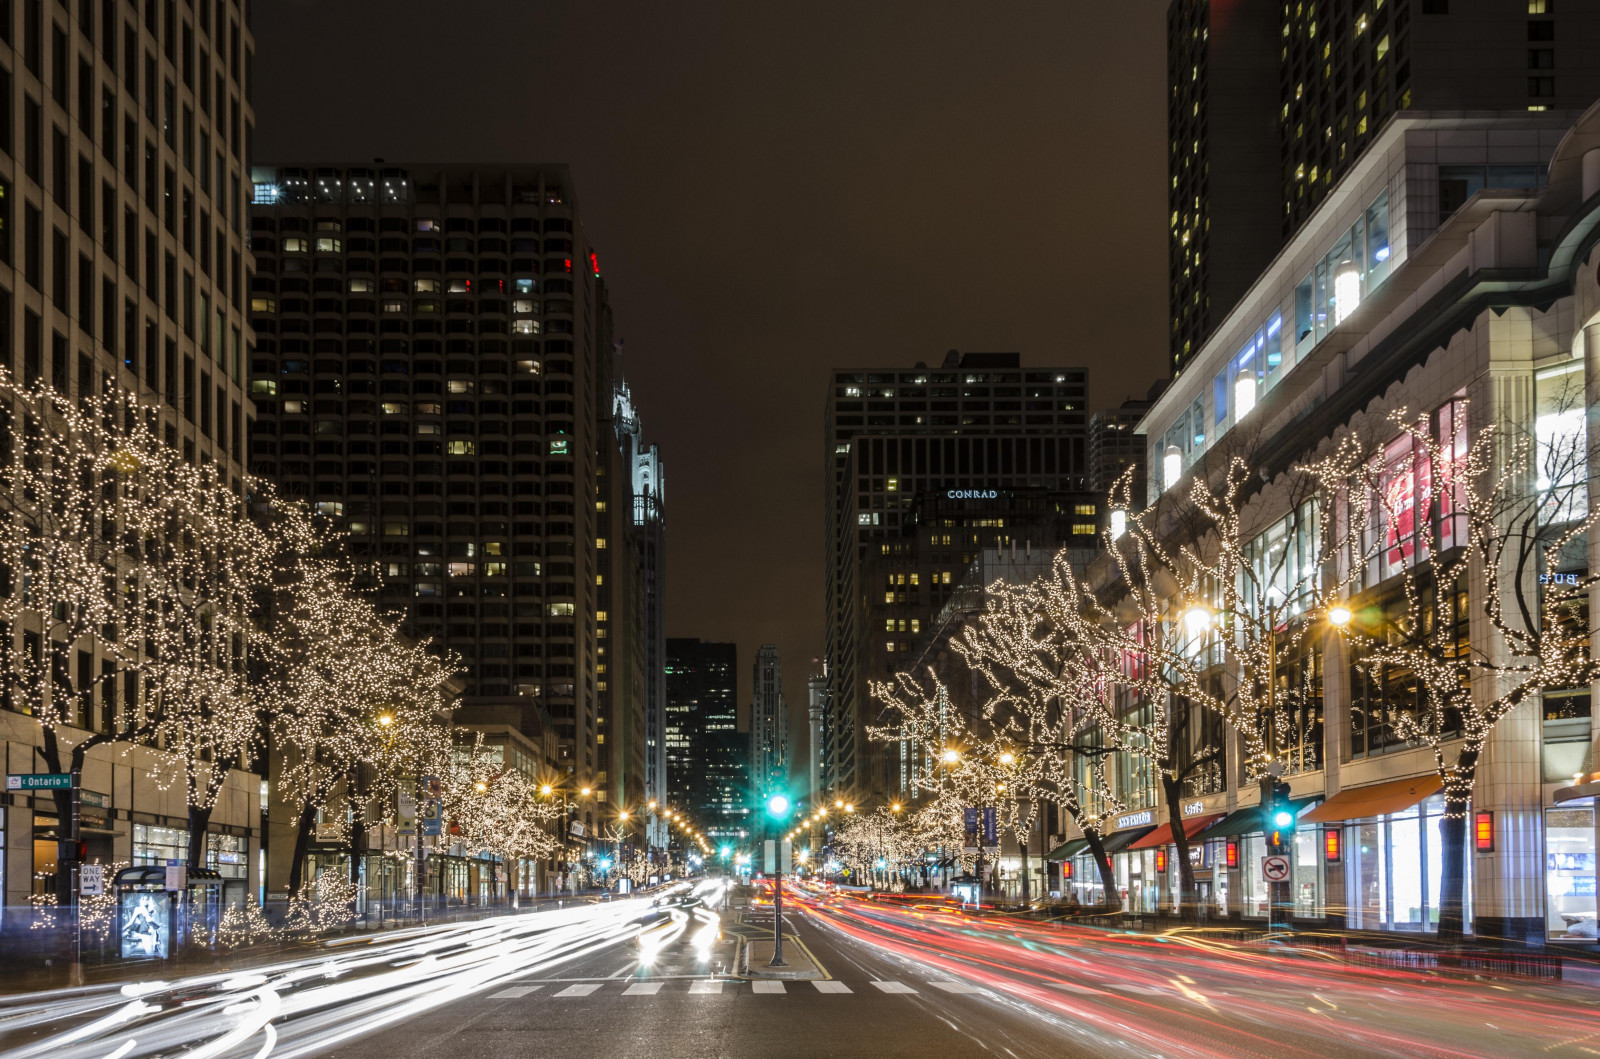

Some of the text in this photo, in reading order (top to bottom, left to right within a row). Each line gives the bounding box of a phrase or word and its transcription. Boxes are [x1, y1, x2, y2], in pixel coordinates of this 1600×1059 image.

[947, 489, 998, 499] CONRAD
[28, 777, 61, 786] Ontario
[83, 867, 100, 875] ONE
[82, 875, 101, 883] WAY
